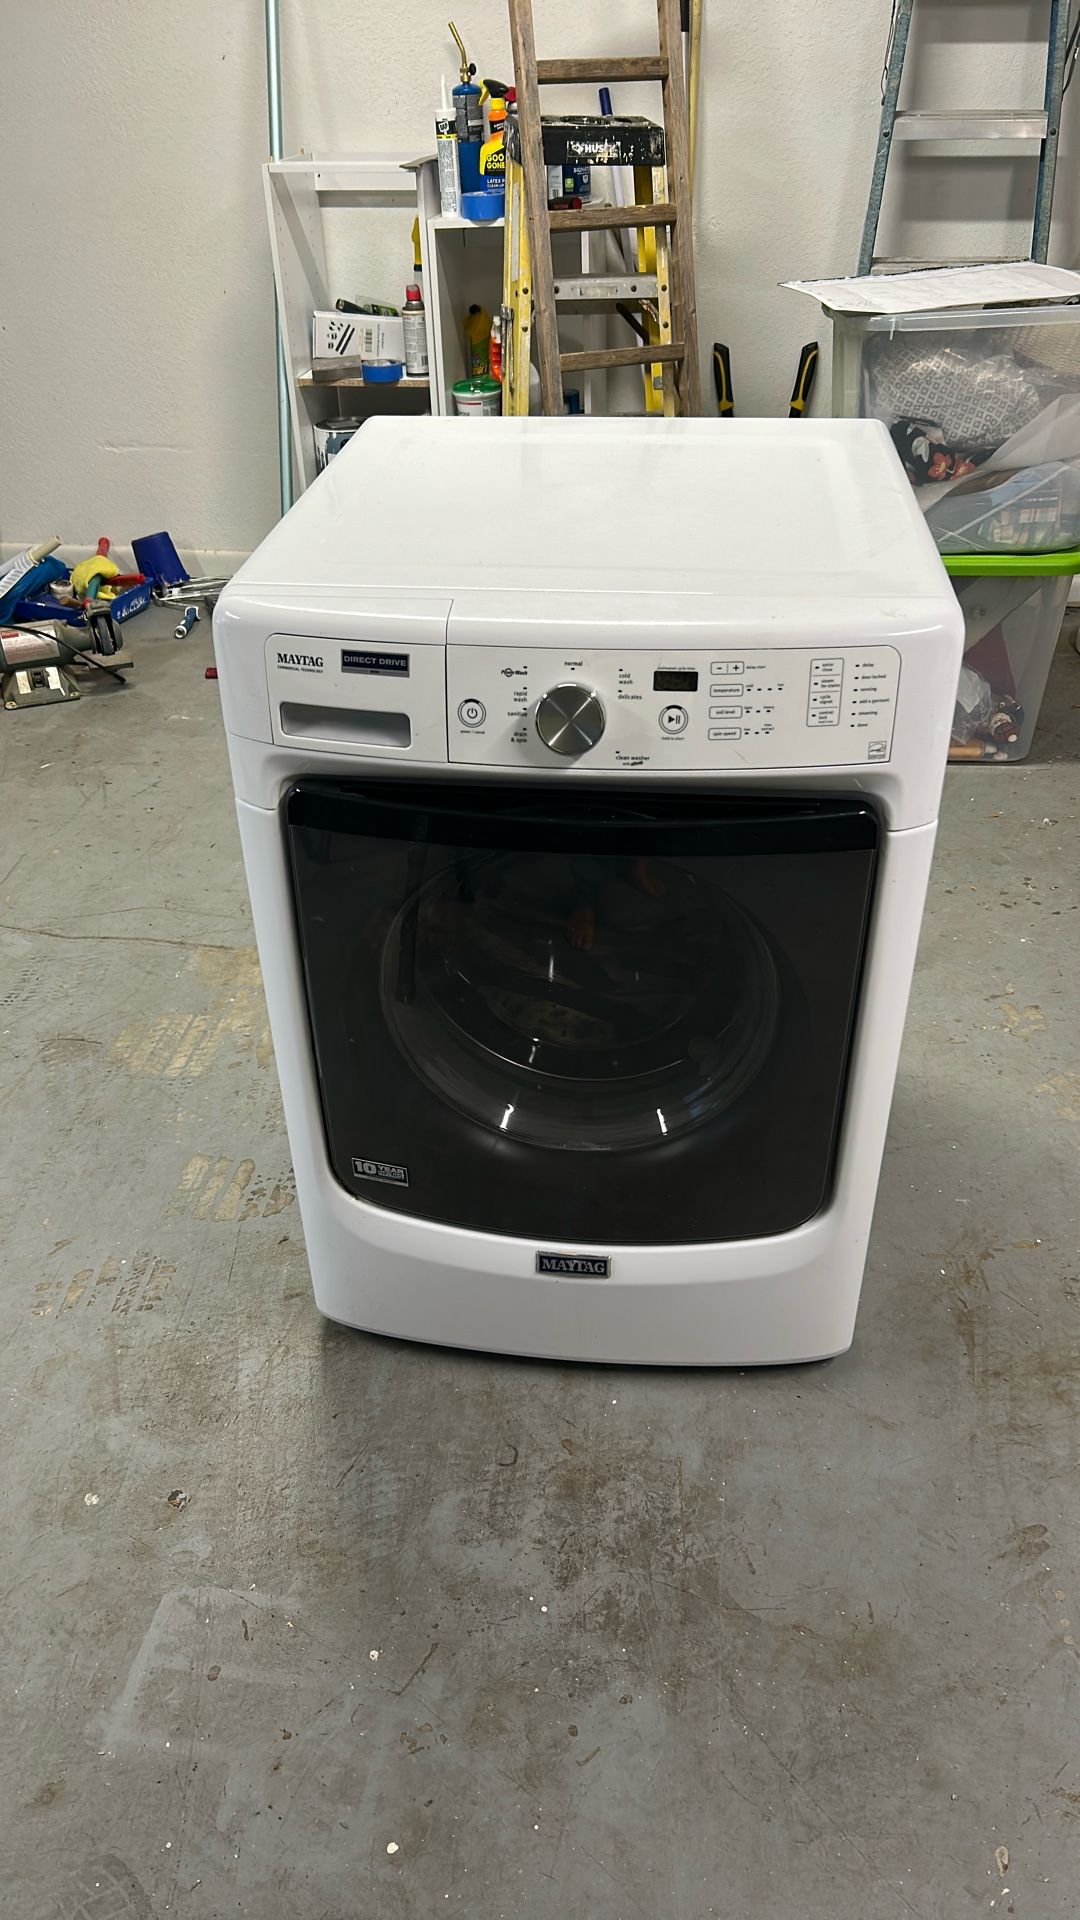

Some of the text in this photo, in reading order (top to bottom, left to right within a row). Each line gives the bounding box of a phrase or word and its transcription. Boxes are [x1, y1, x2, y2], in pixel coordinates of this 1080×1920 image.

[486, 153, 504, 161] GOO
[277, 653, 324, 667] MAYTAG
[343, 655, 407, 667] DIRECT DRIVE
[354, 1161, 377, 1175] 10
[377, 1165, 404, 1174] YEAR
[542, 1258, 606, 1273] MAYTAG
